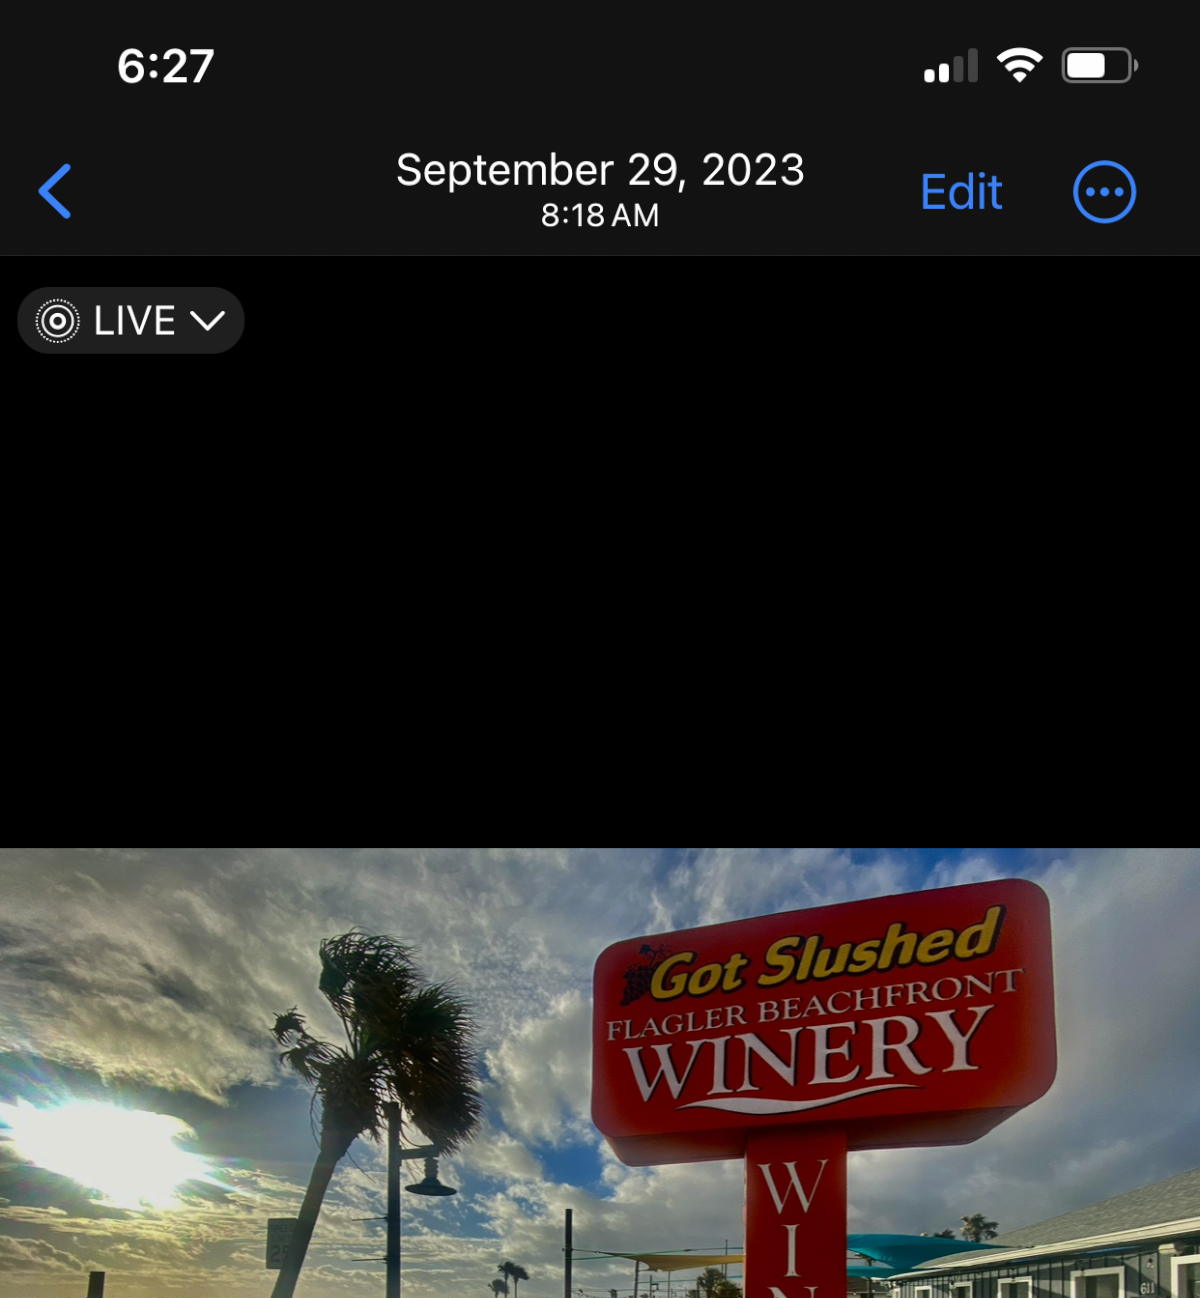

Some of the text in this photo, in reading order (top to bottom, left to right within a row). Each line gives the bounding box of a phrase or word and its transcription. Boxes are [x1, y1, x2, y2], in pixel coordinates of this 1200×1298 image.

[649, 905, 1003, 1001] Got Slushed
[606, 968, 1026, 1042] FLAGLER BEACHFRONT
[623, 1004, 995, 1102] WINERY
[1140, 1282, 1155, 1295] 611
